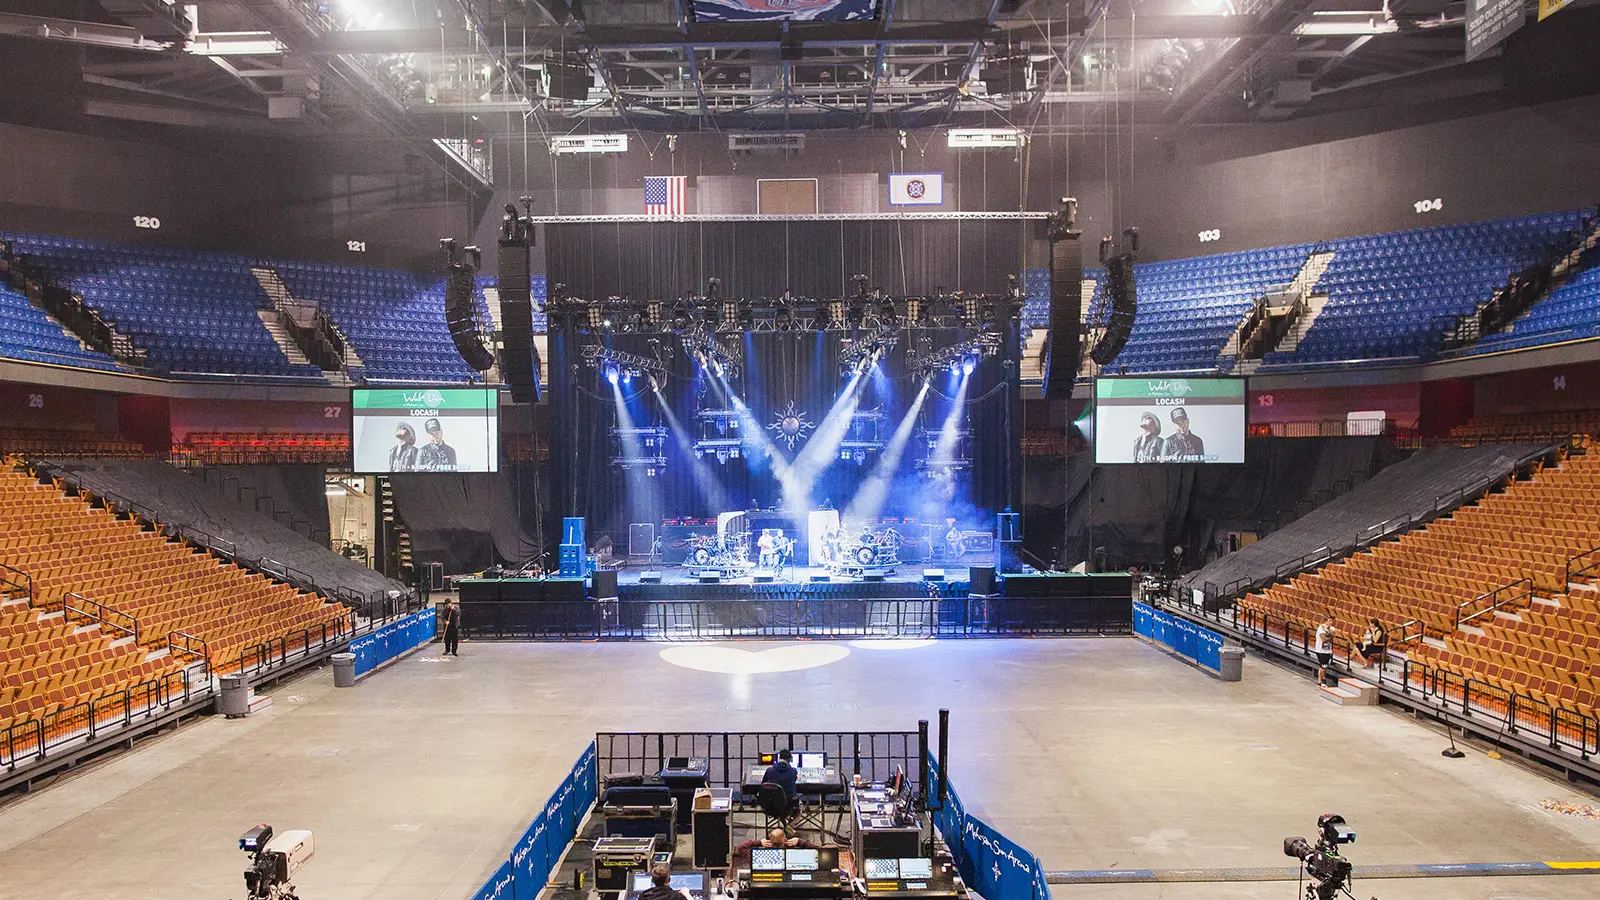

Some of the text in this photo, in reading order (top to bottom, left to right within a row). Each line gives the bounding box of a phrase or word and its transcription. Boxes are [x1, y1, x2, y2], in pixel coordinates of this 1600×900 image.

[1470, 14, 1484, 31] SOLD
[1485, 4, 1498, 20] OUT
[1414, 198, 1442, 213] 104
[133, 215, 161, 229] 120
[1198, 229, 1221, 242] 103
[347, 240, 366, 252] 121
[1553, 376, 1566, 390] 14
[1155, 398, 1185, 406] LOCASH
[1258, 395, 1274, 406] 13
[324, 406, 342, 418] 27
[992, 840, 1008, 859] Sun
[1007, 850, 1030, 873] Arena
